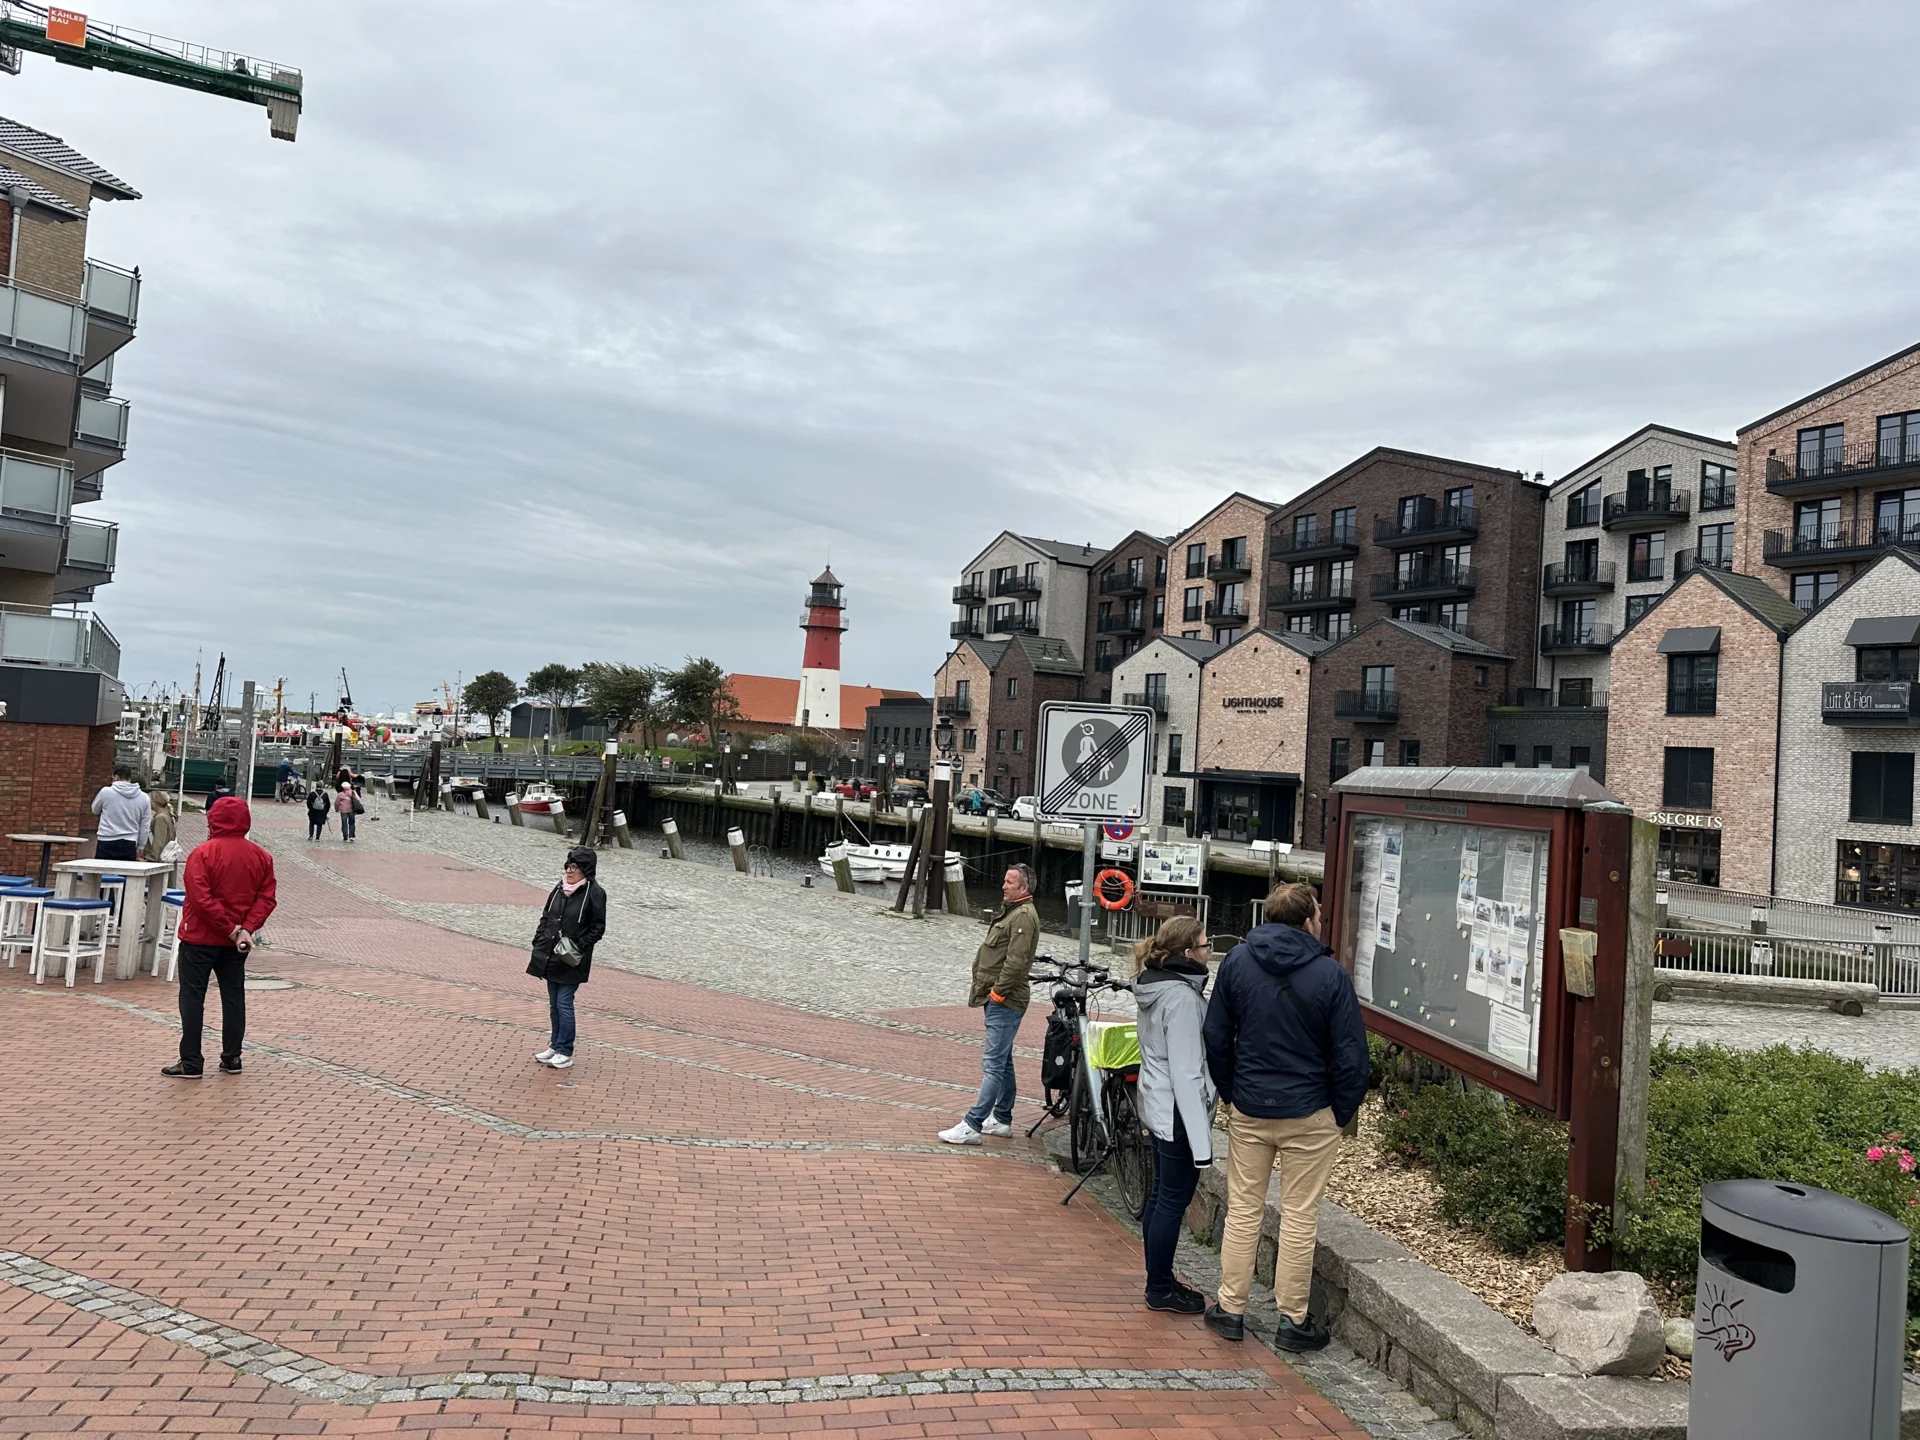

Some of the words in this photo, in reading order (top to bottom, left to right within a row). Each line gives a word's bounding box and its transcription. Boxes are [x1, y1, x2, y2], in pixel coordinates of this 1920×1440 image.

[51, 9, 85, 23] KÄHLER
[51, 15, 69, 25] BAU
[1222, 697, 1284, 708] LIGHTHOUSE
[1844, 691, 1851, 709] &
[1853, 691, 1872, 709] Fien
[1067, 792, 1118, 810] ZONE
[1649, 811, 1723, 829] 5SECRETS
